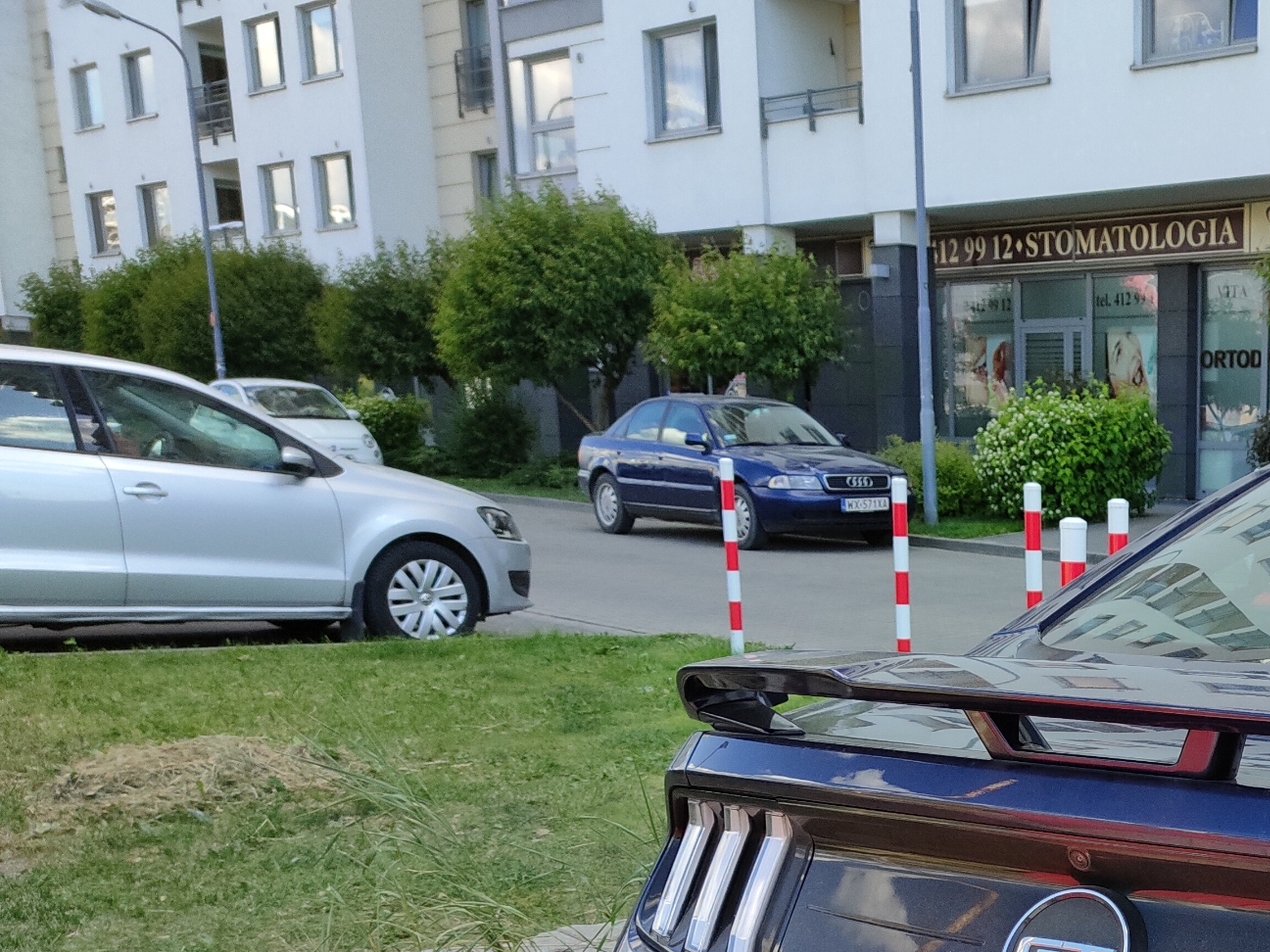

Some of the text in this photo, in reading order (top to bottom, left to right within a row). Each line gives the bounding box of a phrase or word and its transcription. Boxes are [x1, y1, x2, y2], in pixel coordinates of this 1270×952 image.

[964, 235, 986, 263] 99
[1025, 216, 1237, 258] STOMATOLOGIA
[1114, 291, 1132, 307] 412
[1201, 350, 1262, 369] ORTOD
